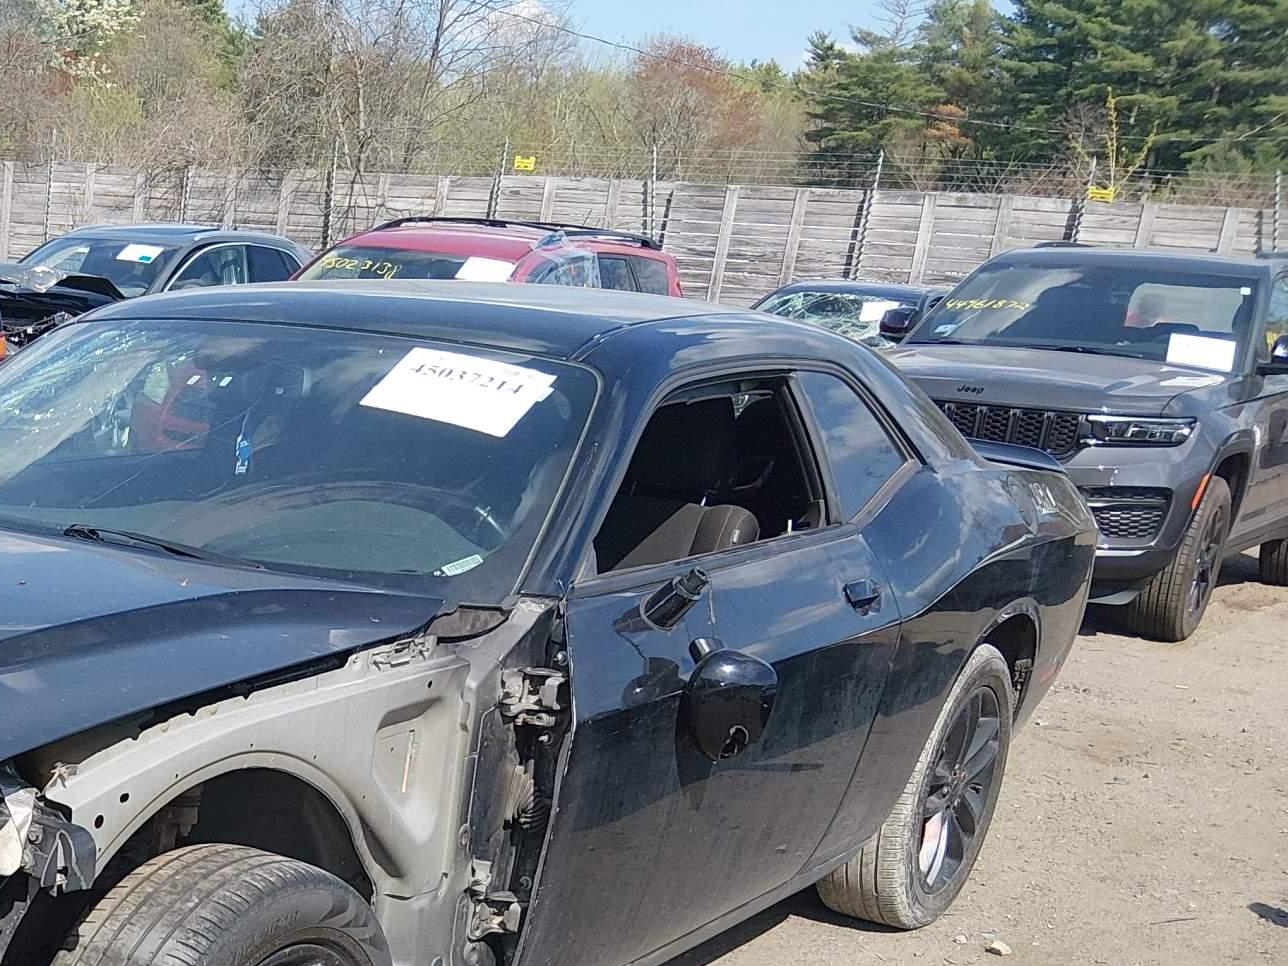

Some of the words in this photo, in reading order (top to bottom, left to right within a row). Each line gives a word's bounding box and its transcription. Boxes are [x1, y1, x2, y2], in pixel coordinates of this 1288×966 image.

[945, 299, 1031, 311] 44961872
[410, 363, 525, 395] 45037214
[956, 384, 985, 395] Jeep
